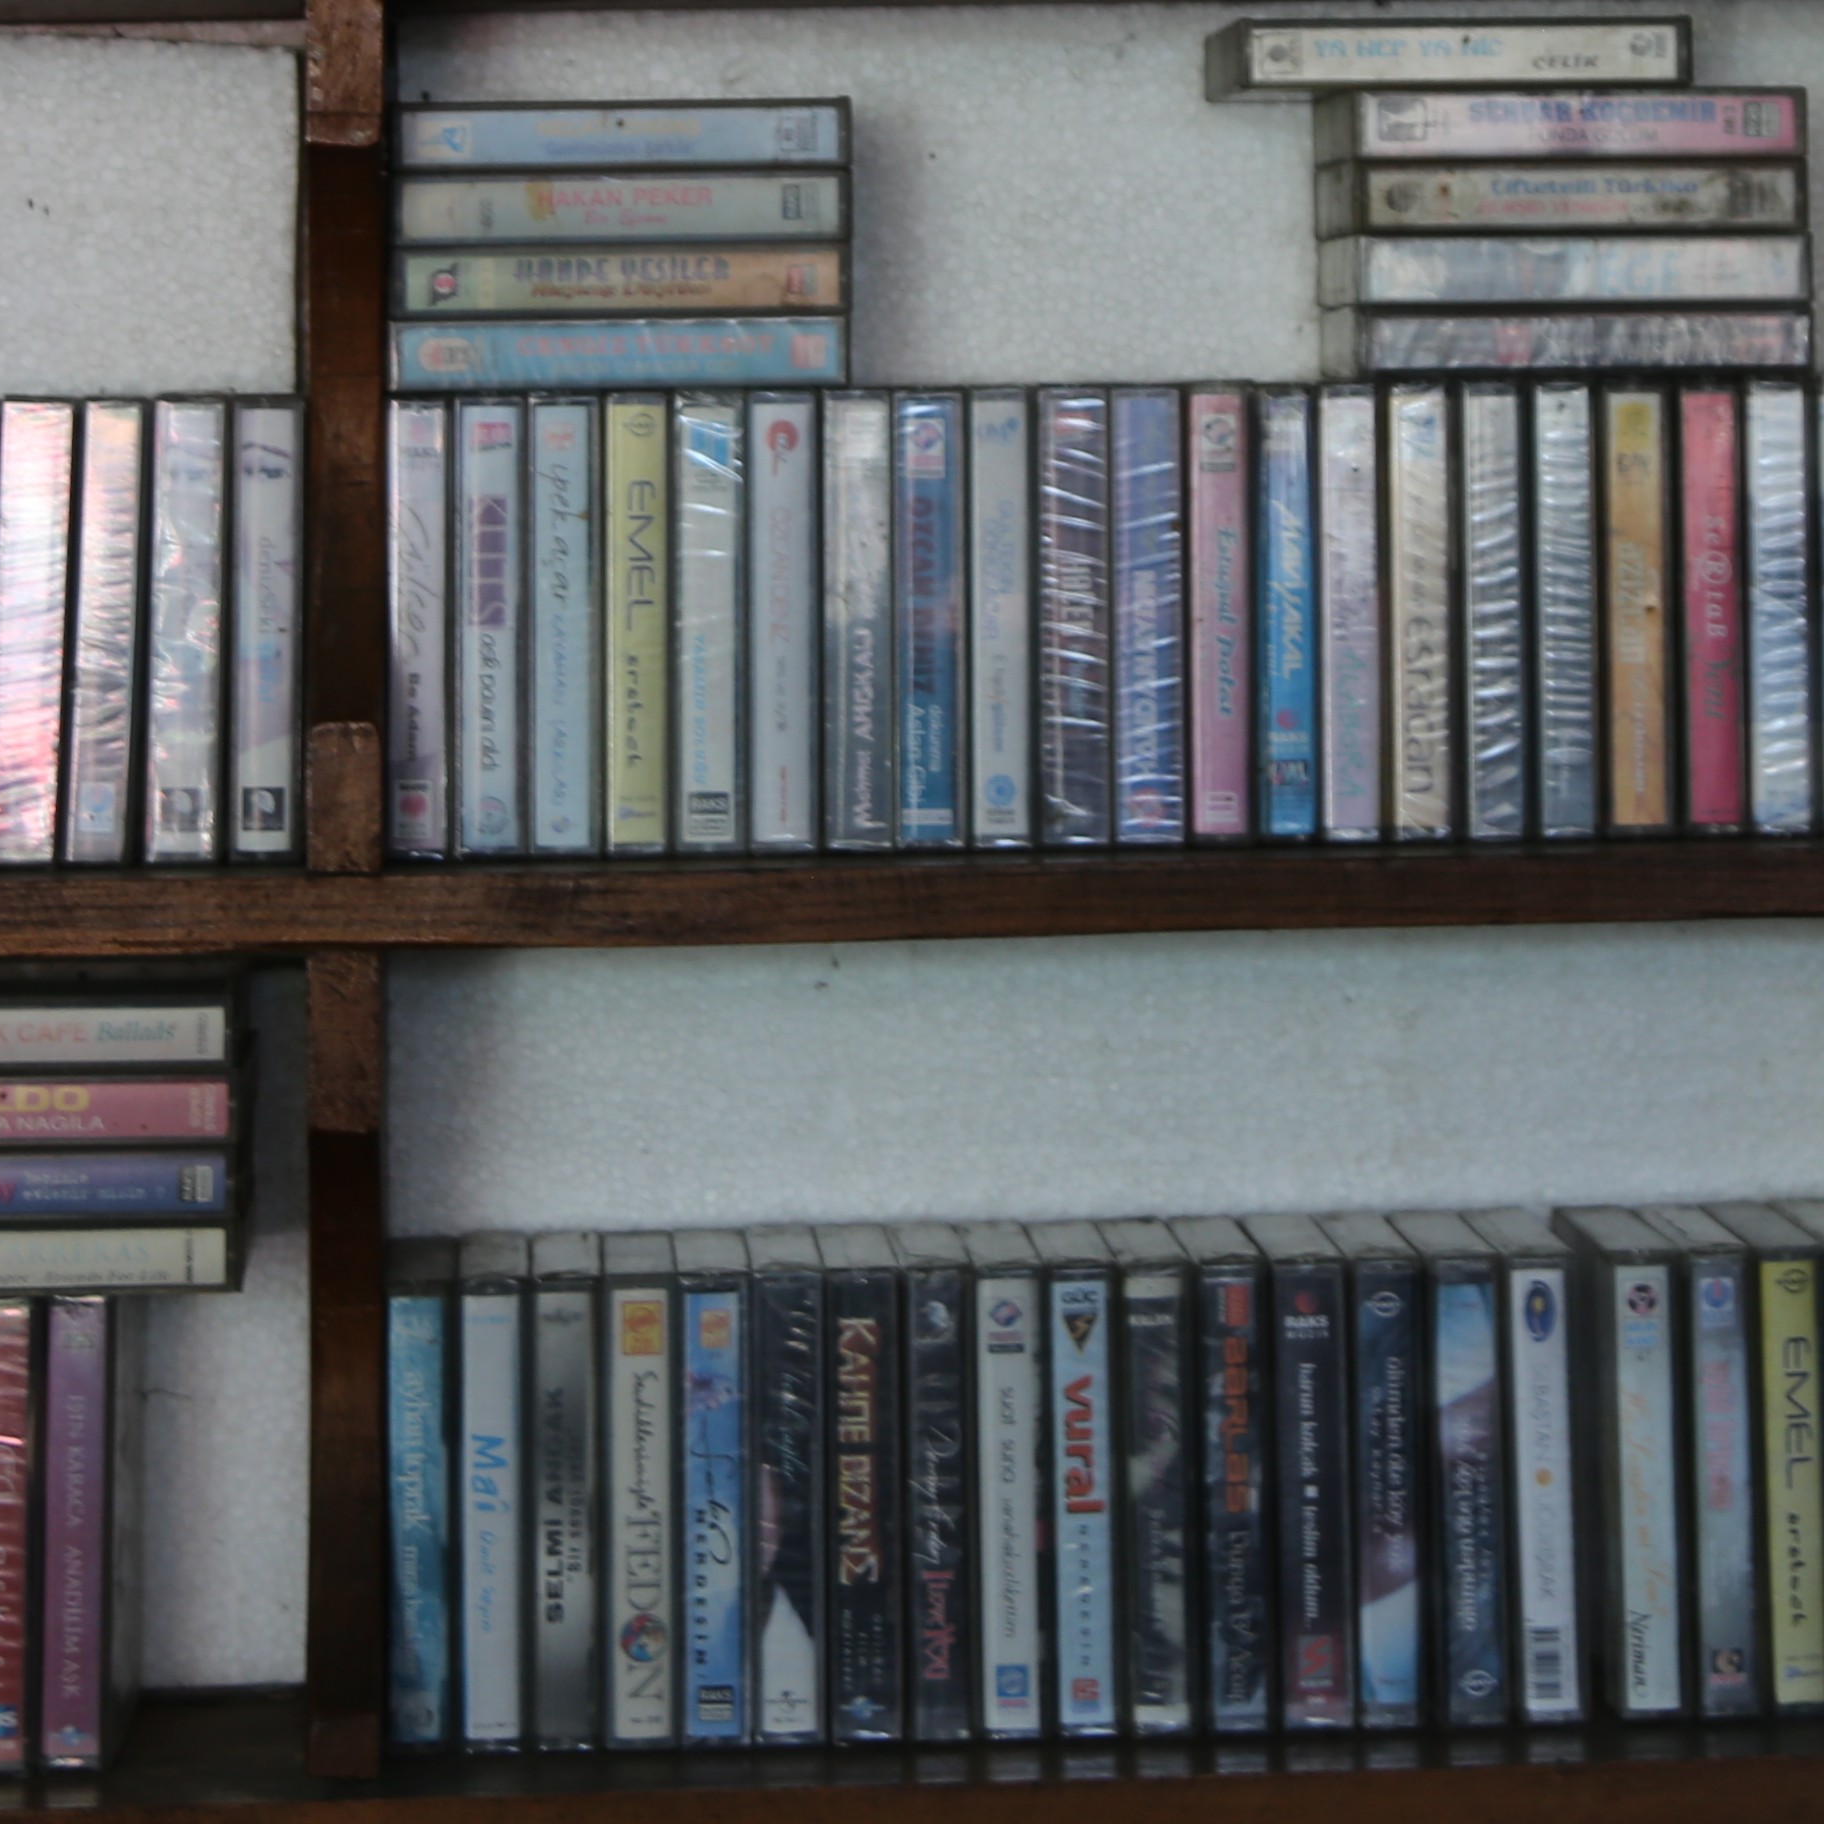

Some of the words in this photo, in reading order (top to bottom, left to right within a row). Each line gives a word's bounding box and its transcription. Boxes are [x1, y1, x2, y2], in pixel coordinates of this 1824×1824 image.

[626, 480, 656, 631] EMEL
[406, 706, 420, 762] Adam
[928, 705, 943, 772] dokunma
[1336, 649, 1367, 798] ALABORA
[17, 1022, 89, 1043] CAFE
[398, 1371, 430, 1451] ayhan
[1224, 1335, 1249, 1513] BARLAS
[1299, 1362, 1318, 1415] harun
[1385, 1356, 1406, 1448] ölümden
[1782, 1336, 1812, 1489] EMEL
[1064, 1376, 1105, 1514] vural
[65, 1445, 82, 1528] KARACA
[398, 1453, 431, 1532] toprak
[1300, 1504, 1320, 1557] teslim
[59, 1659, 80, 1698] AŞK
[1629, 1609, 1654, 1689] Neriman
